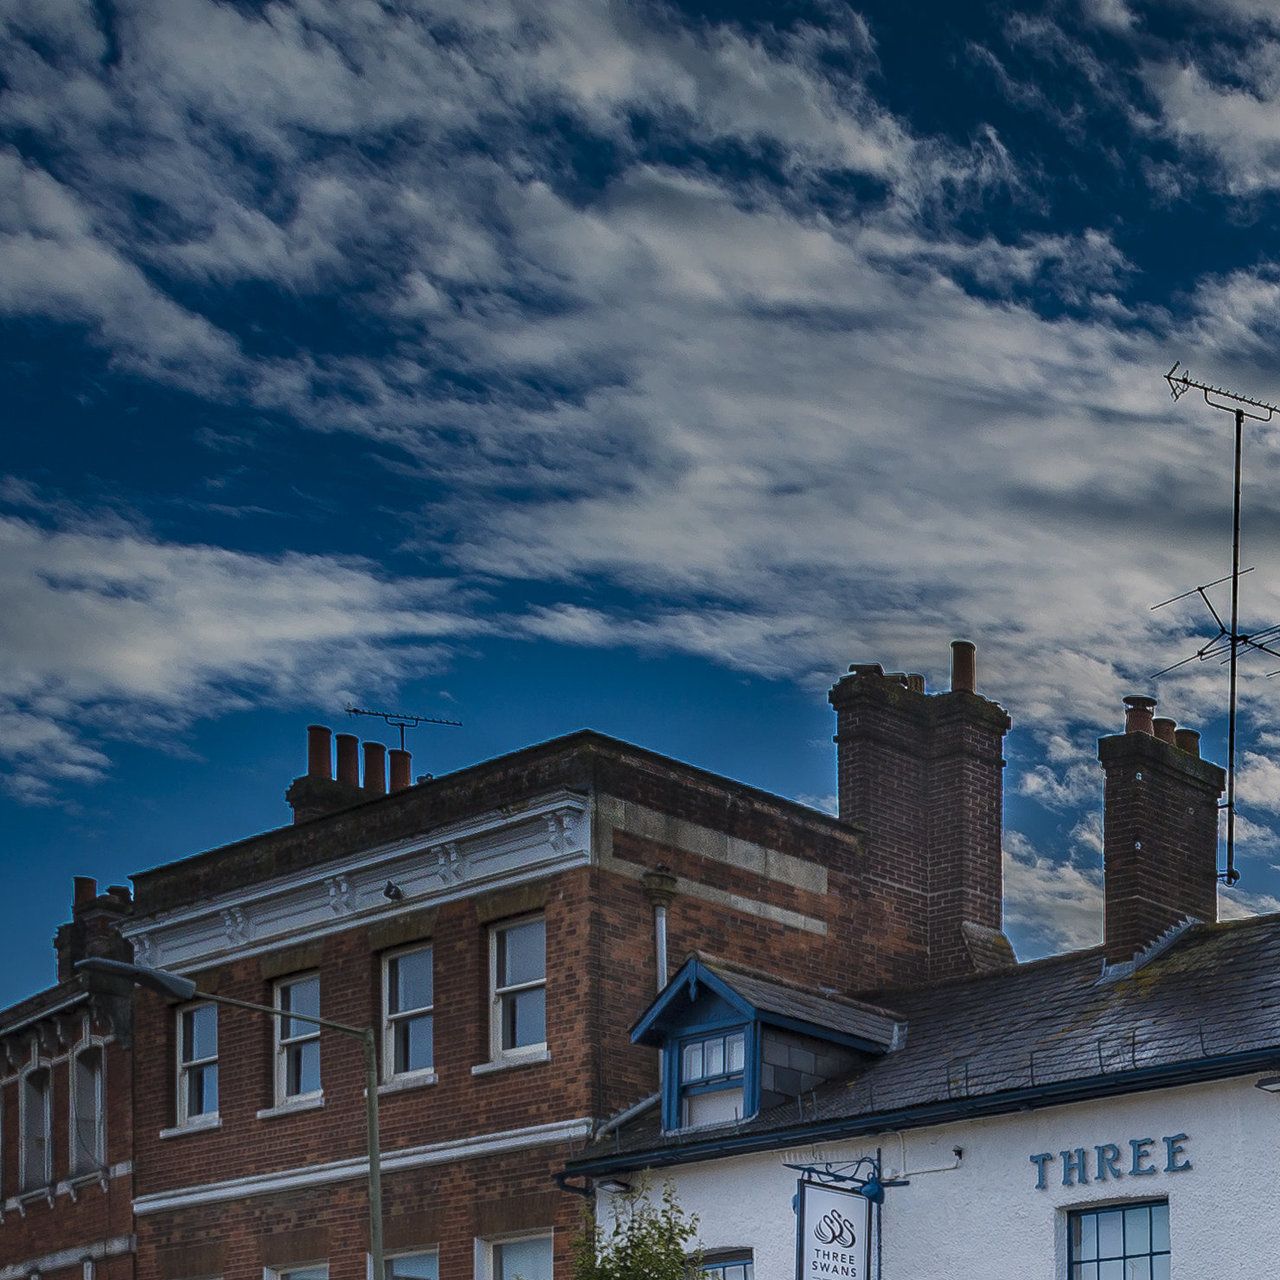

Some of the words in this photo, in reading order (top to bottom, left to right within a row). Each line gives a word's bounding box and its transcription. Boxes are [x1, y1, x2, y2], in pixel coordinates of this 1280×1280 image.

[1030, 1132, 1193, 1190] THREE
[814, 1248, 855, 1265] THREE
[811, 1260, 857, 1278] SWANS
